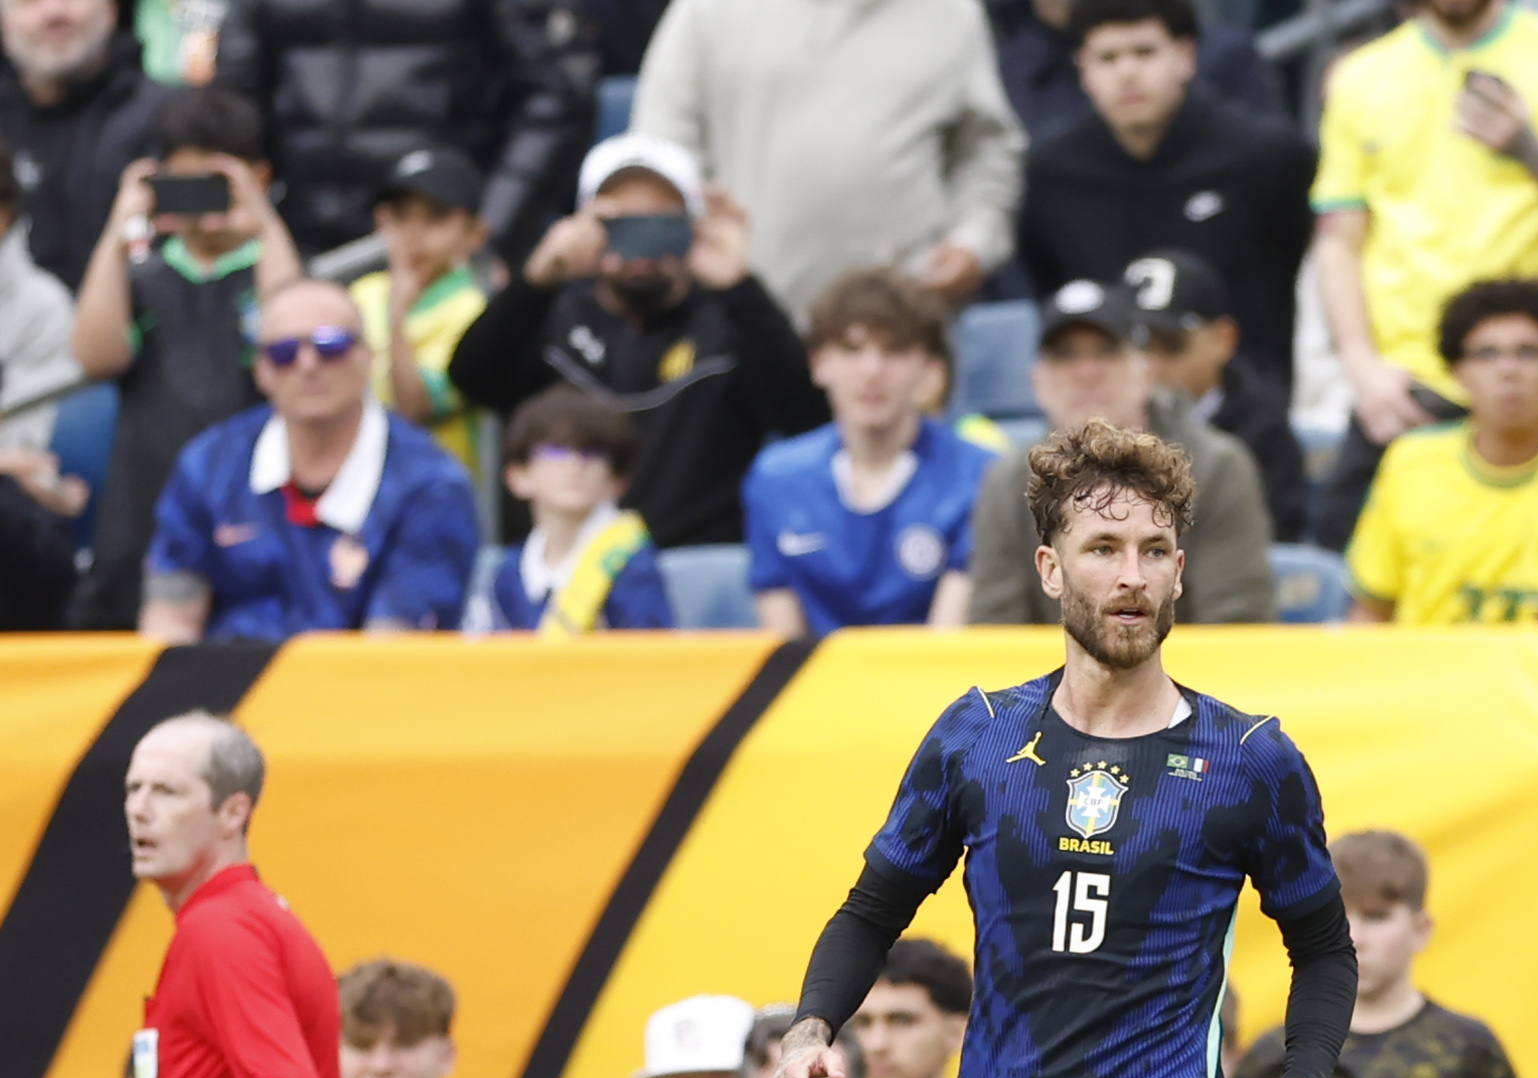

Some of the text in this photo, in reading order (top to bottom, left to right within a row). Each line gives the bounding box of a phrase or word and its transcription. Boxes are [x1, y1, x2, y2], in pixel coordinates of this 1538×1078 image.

[1083, 797, 1104, 806] CBF
[1058, 836, 1115, 855] BRASIL
[1052, 870, 1111, 954] 15
